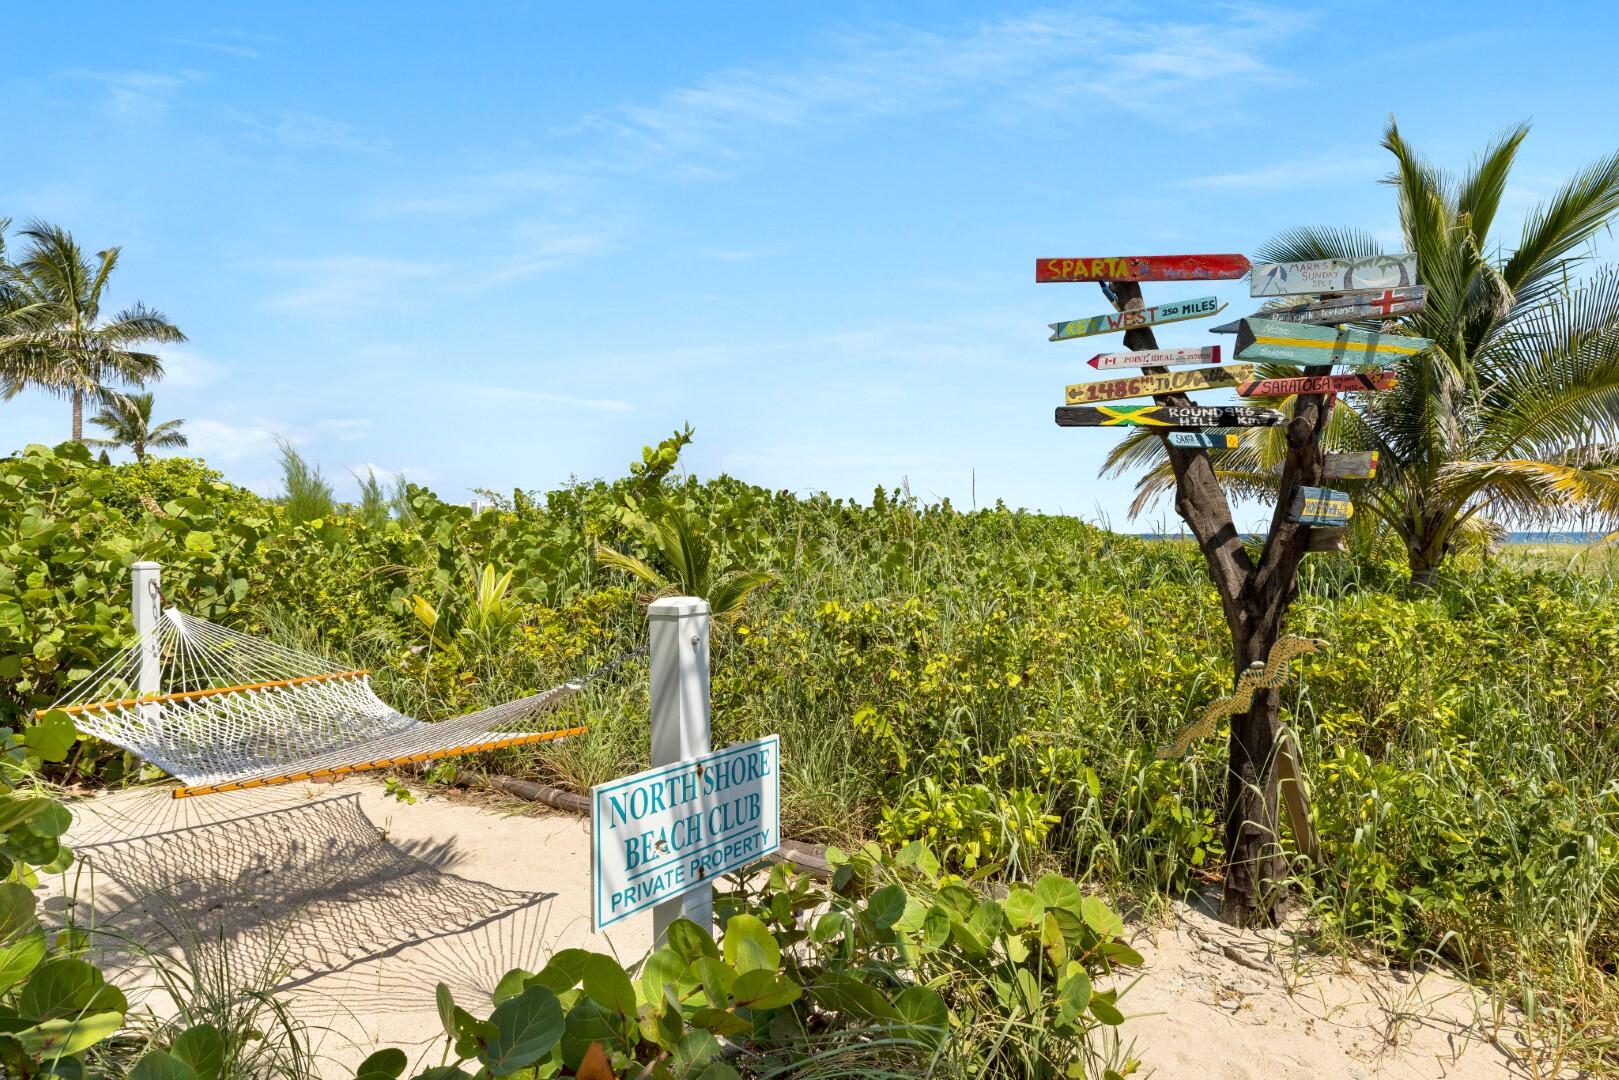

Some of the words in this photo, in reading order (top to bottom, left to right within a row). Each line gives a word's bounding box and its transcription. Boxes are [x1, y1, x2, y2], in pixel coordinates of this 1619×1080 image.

[1047, 257, 1129, 279] SPARTA
[1301, 272, 1339, 281] SUNDAY
[1065, 317, 1100, 336] KEY
[1106, 306, 1160, 329] WEST
[1162, 307, 1179, 317] 250
[1182, 300, 1216, 314] MILES
[1322, 306, 1354, 318] Iceland
[1150, 354, 1174, 362] IDEAL
[1086, 381, 1142, 400] 1486
[1156, 378, 1170, 390] TO
[1261, 375, 1331, 394] SARATOGA
[1168, 408, 1224, 417] ROUND
[1225, 408, 1256, 417] 946
[1179, 416, 1219, 426] HILL
[609, 770, 698, 829] NORTH
[703, 748, 771, 796] SHORE
[624, 812, 704, 872] BEACH
[708, 792, 760, 837] CLUB
[610, 864, 686, 913] PRIVATE
[690, 828, 771, 878] PROPERTY
